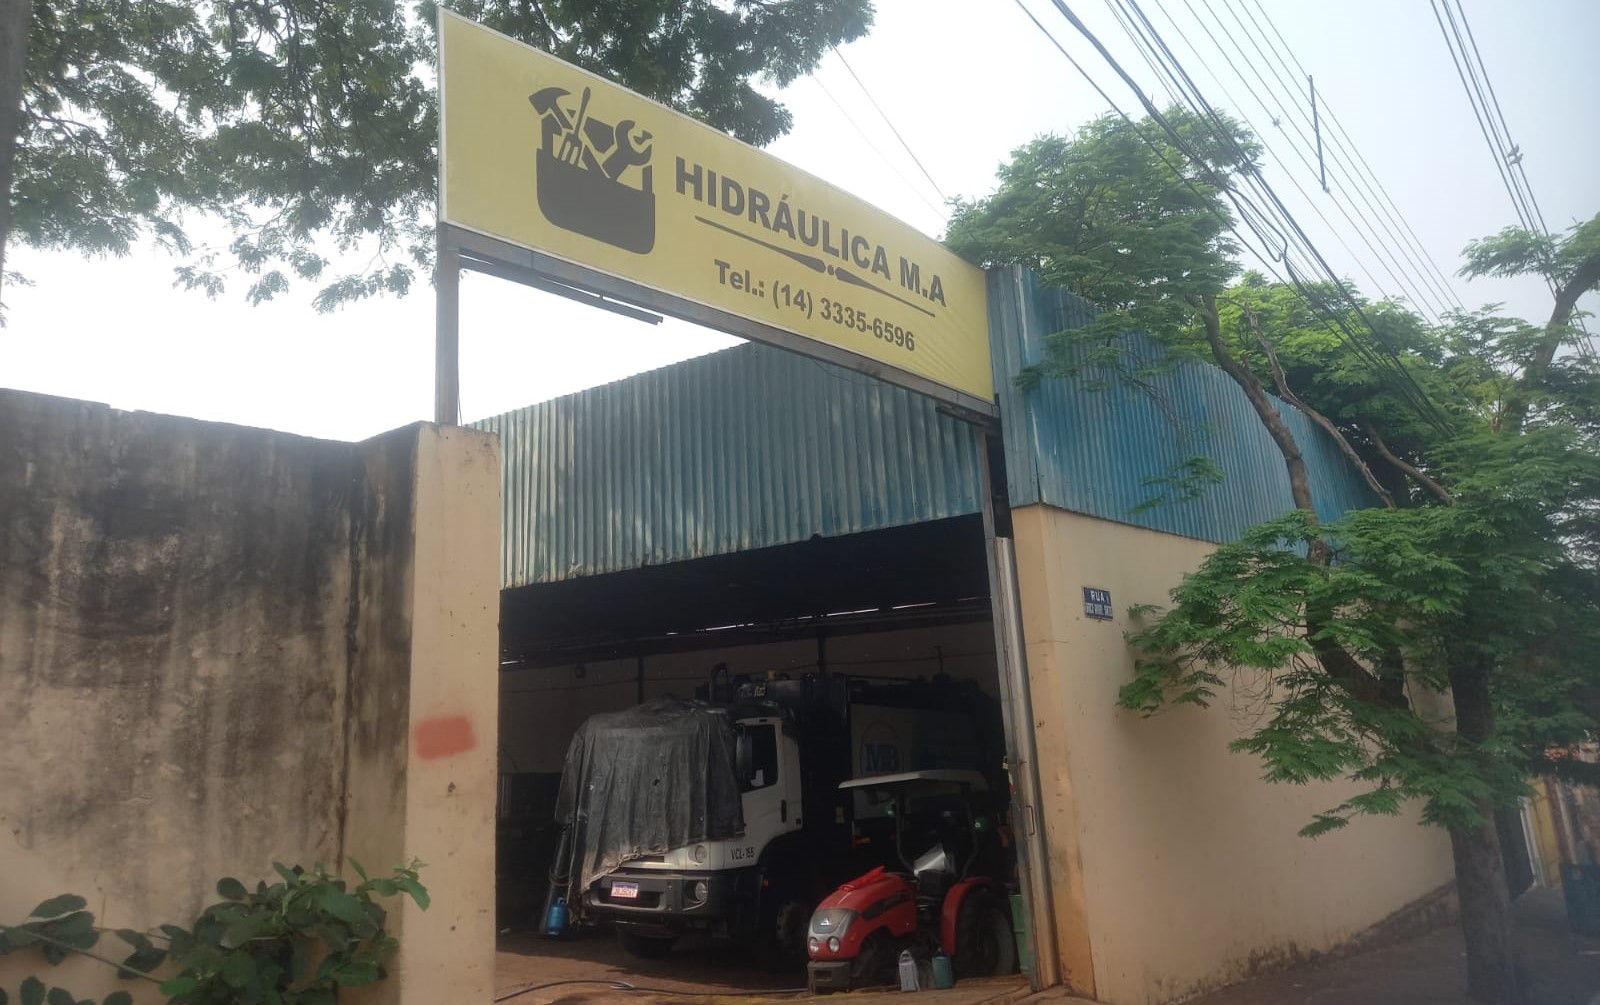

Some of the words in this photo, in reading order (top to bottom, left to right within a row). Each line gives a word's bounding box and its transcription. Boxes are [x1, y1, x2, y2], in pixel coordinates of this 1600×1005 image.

[676, 155, 891, 281] HIDRÁULICA
[900, 256, 946, 307] M.A
[714, 258, 765, 298] Tel.:
[773, 280, 813, 320] (14)
[820, 297, 915, 351] 3335-6596
[1090, 590, 1106, 602] RUA
